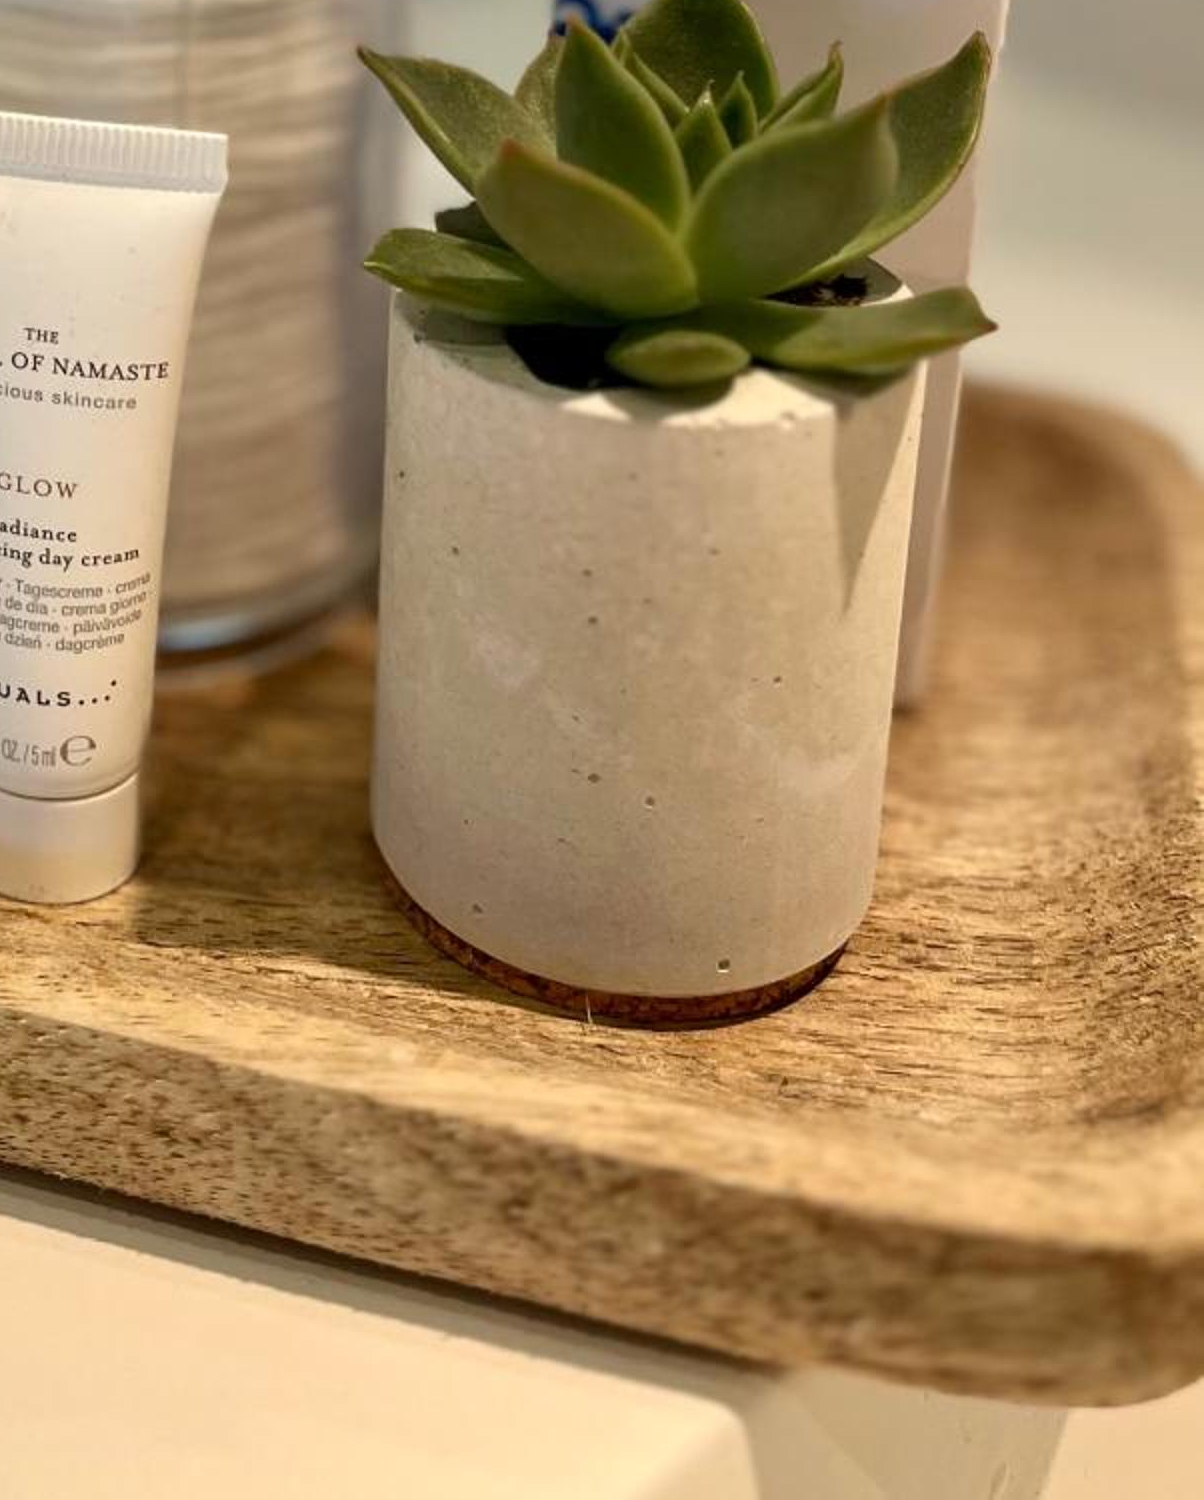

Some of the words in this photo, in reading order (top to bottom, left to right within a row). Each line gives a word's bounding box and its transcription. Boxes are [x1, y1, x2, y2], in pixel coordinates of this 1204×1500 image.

[24, 327, 60, 344] THE
[11, 351, 44, 373] OF
[52, 357, 170, 382] NAMASTE
[52, 390, 137, 410] skincare
[39, 547, 73, 573] day
[81, 548, 140, 567] cream
[14, 577, 103, 599] Tagescreme
[5, 595, 22, 611] de
[61, 603, 107, 617] crema
